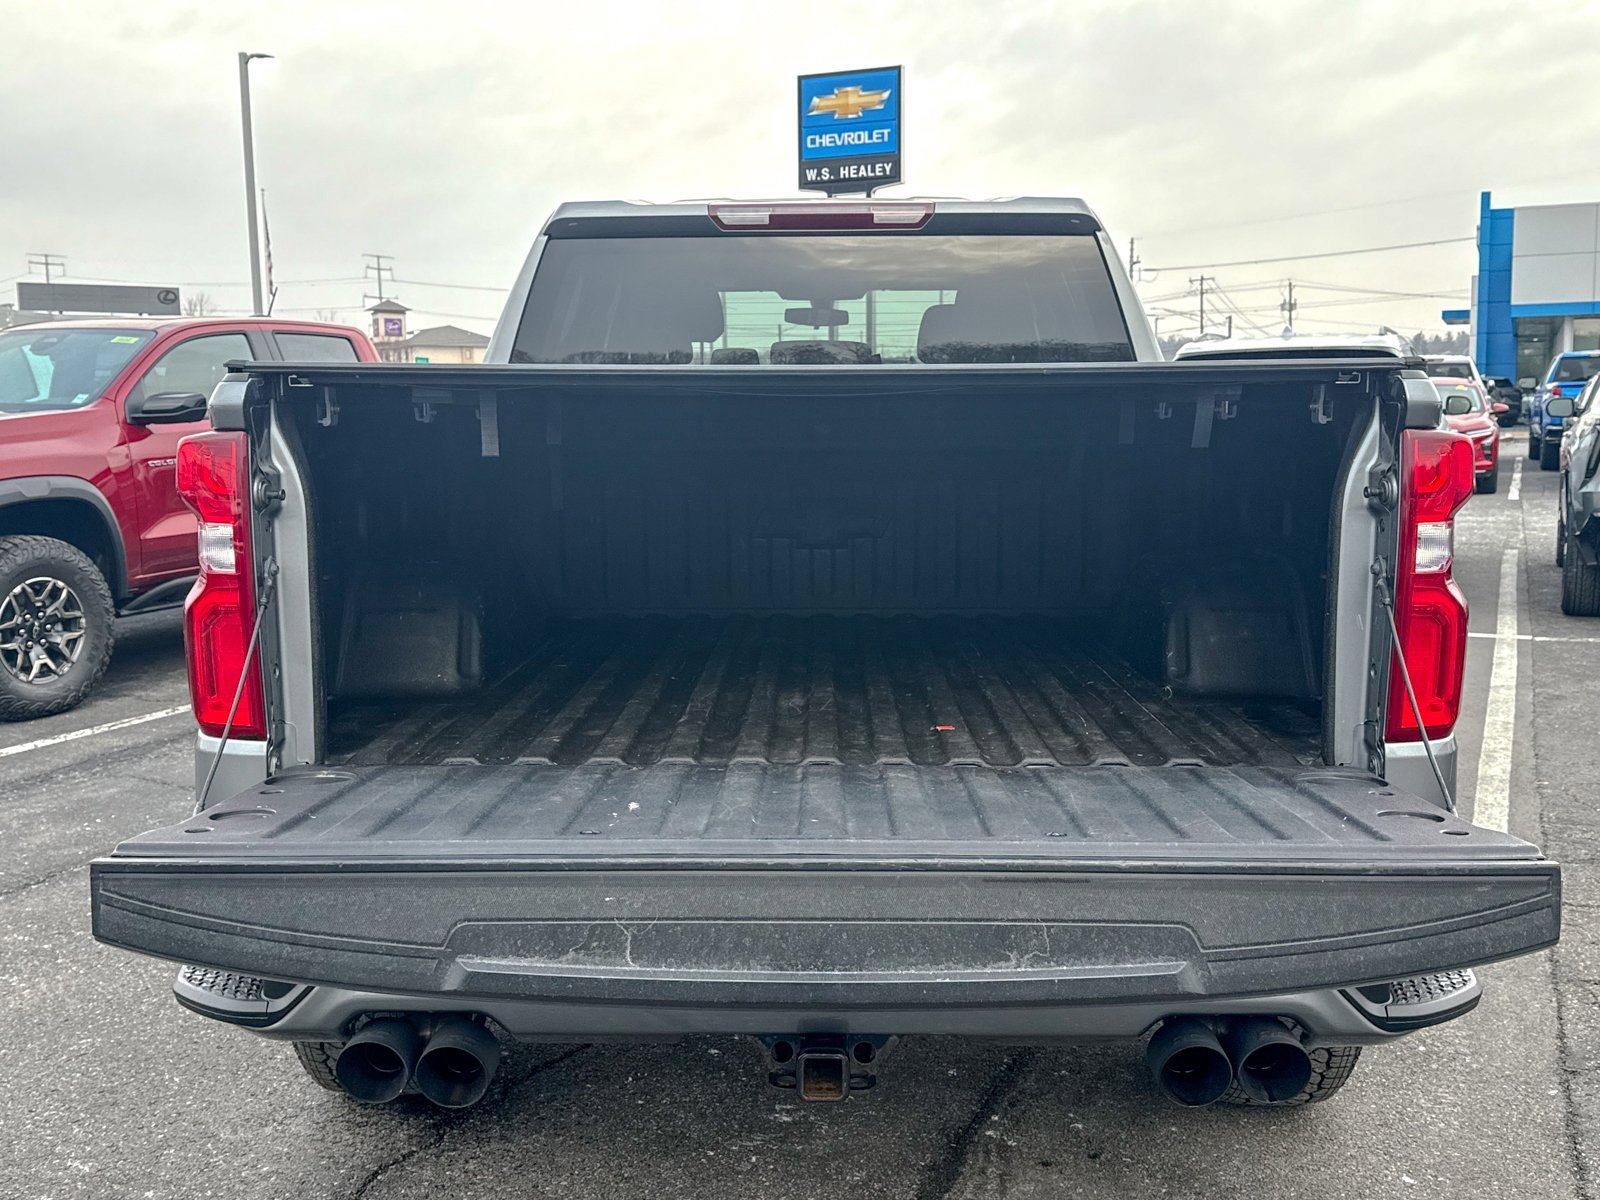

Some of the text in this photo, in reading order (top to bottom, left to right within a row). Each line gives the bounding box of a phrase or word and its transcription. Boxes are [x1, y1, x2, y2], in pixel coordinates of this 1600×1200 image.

[806, 129, 891, 148] CHEVROLET
[805, 163, 892, 181] W.S. HEALEY
